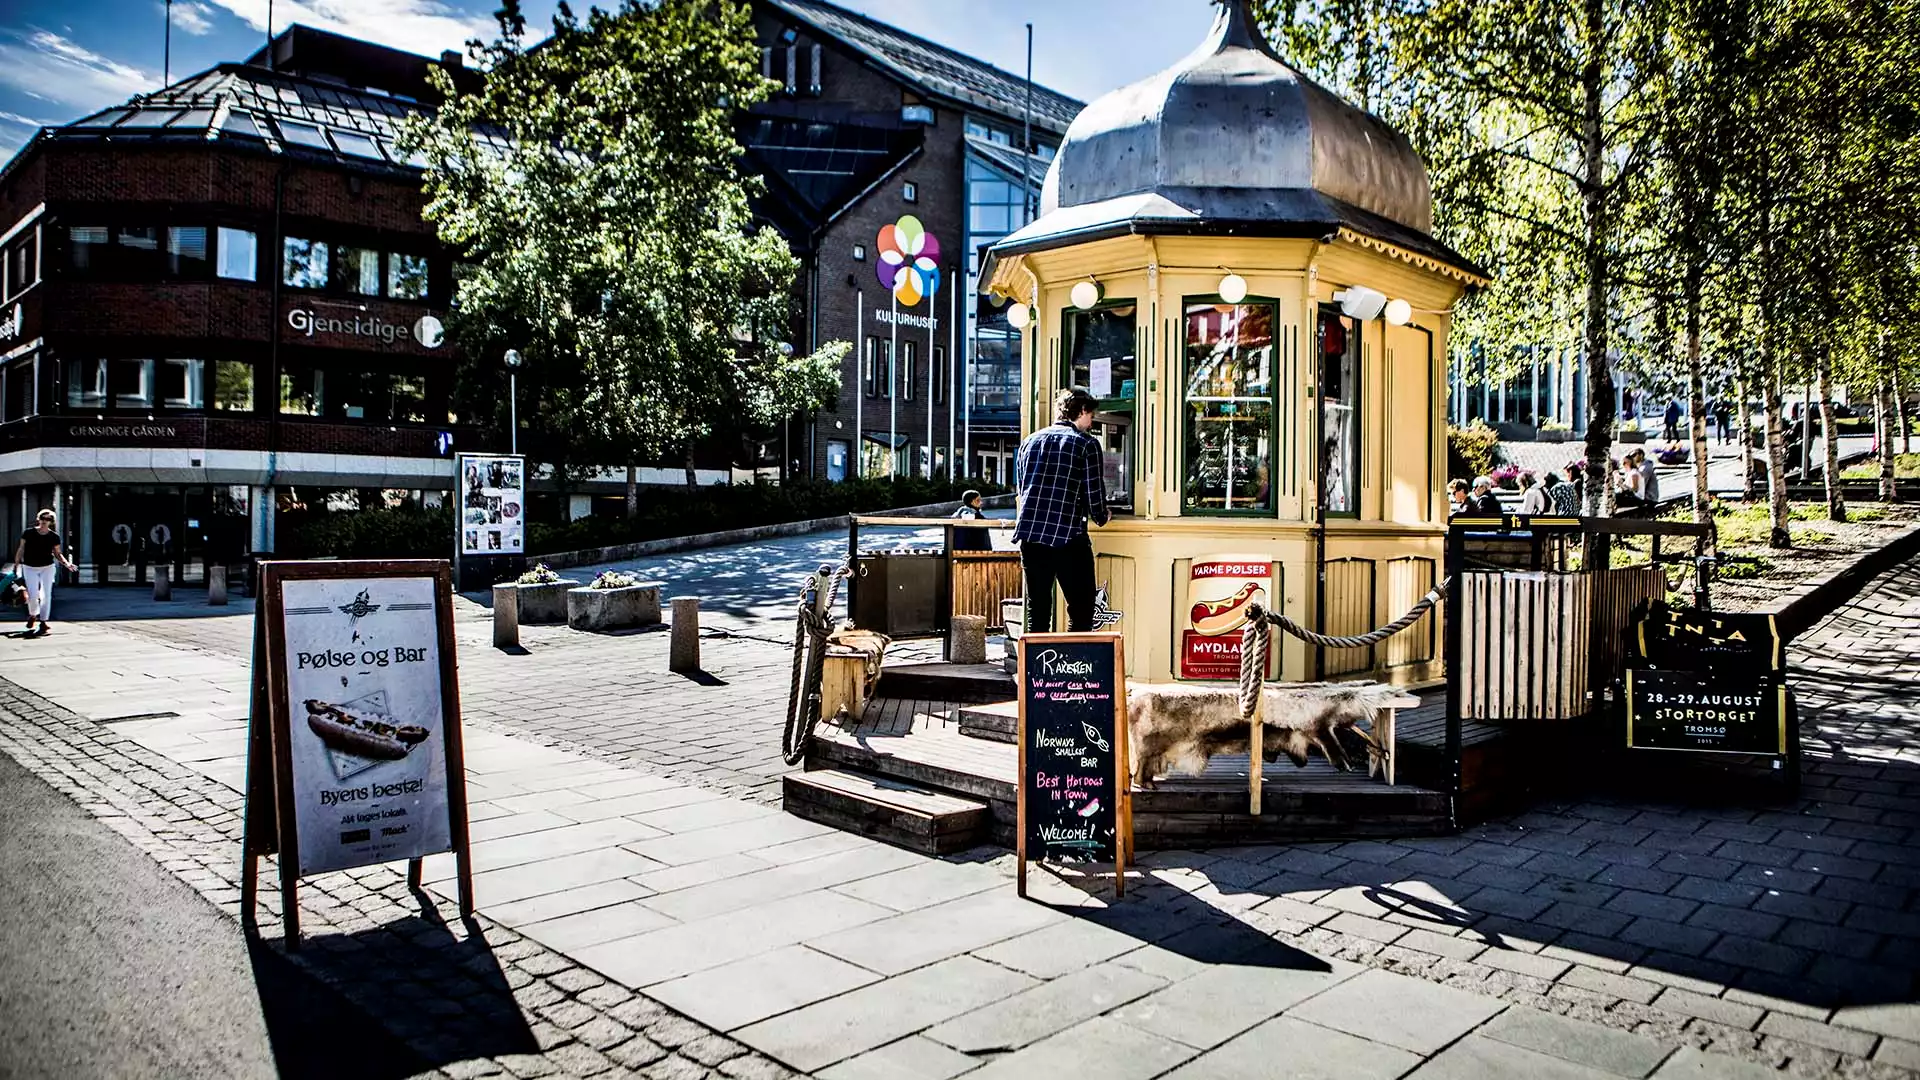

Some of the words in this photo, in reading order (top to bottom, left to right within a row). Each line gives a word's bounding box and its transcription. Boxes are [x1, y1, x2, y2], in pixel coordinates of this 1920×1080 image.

[288, 308, 409, 344] Gjensidige
[69, 425, 130, 437] GJENSIDIGE
[131, 425, 176, 437] GÅRDEN
[1194, 565, 1224, 576] VARME
[1225, 564, 1267, 575] PØLSER
[297, 649, 356, 670] Pølse
[361, 649, 390, 668] og
[394, 646, 428, 664] Bar
[1655, 708, 1756, 723] STORTORGET
[1684, 725, 1726, 734] TROMSØ
[1080, 757, 1098, 768] BAR
[1037, 771, 1060, 788] BEST
[320, 786, 369, 807] Byens
[372, 778, 424, 799] beste!
[1051, 790, 1061, 800] IN
[1064, 789, 1088, 800] TOWN
